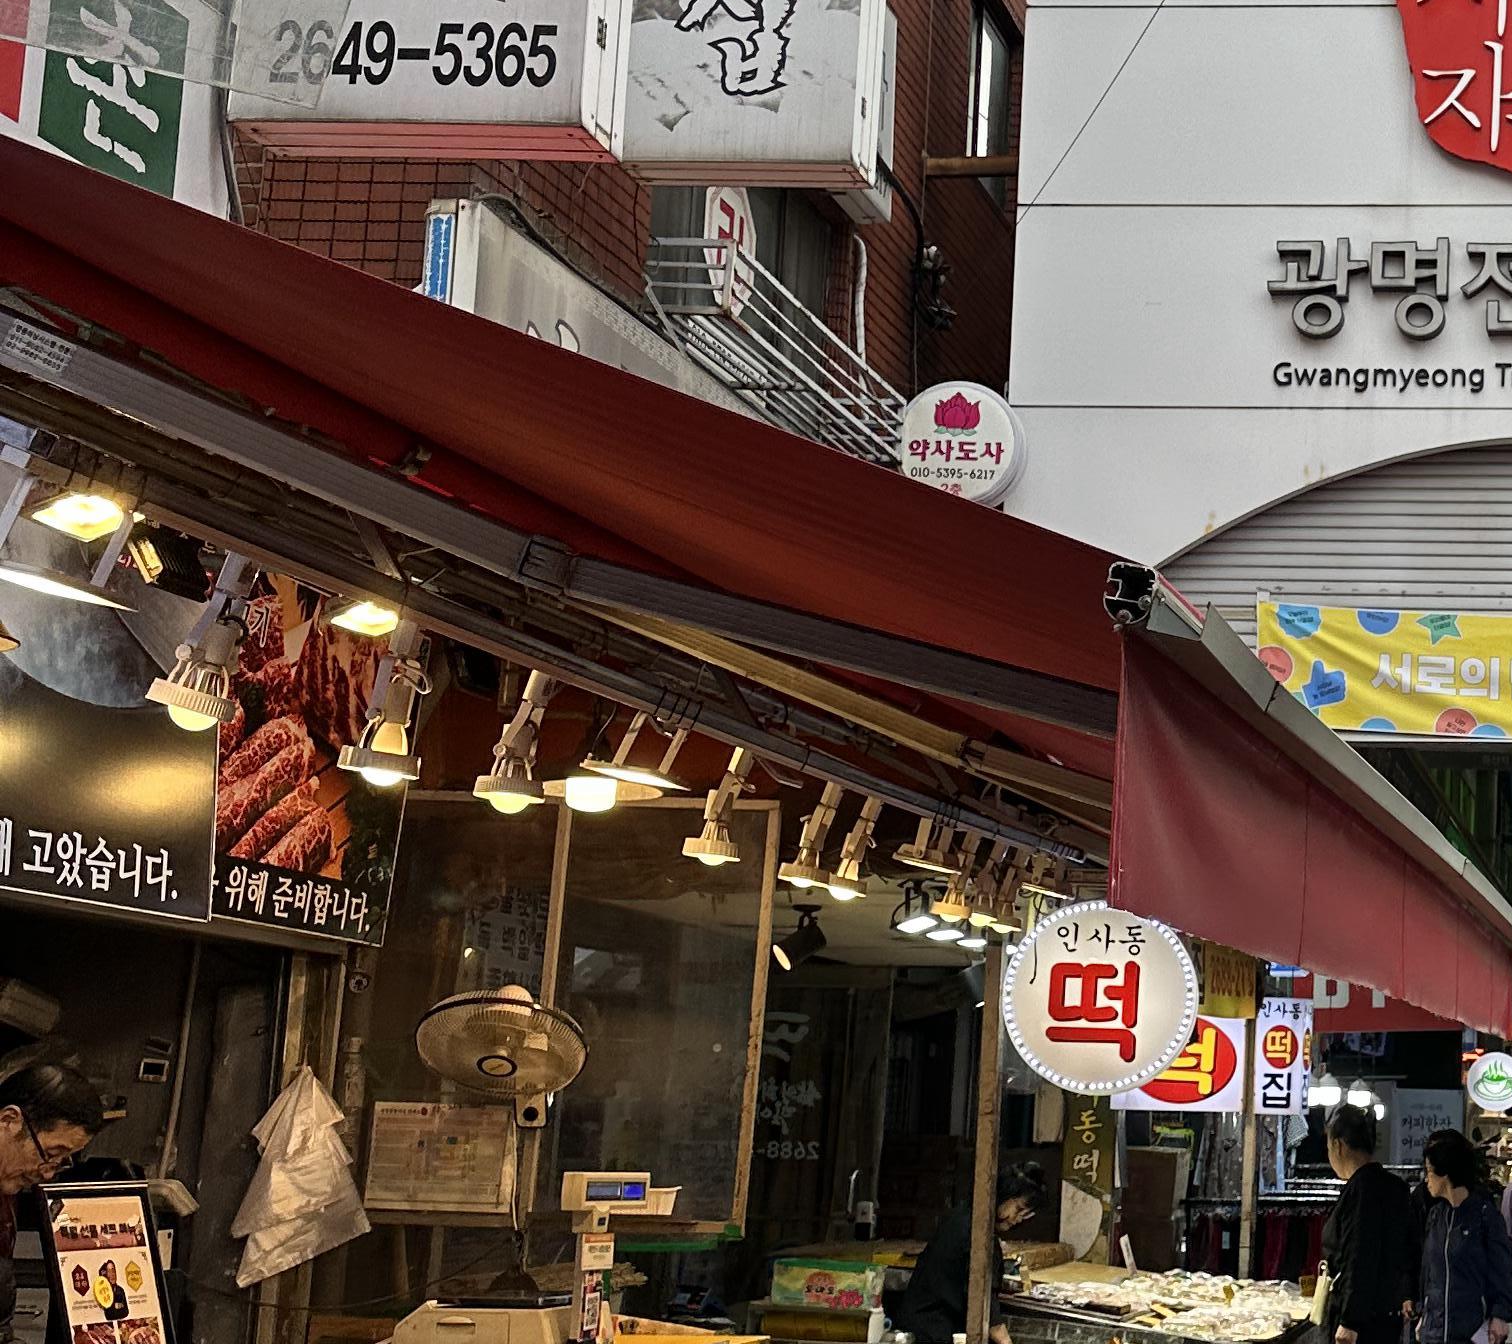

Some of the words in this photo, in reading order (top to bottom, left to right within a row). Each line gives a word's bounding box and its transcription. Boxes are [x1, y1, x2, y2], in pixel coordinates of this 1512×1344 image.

[268, 21, 558, 87] 2649-5365
[1272, 361, 1486, 394] Gwangmyeong
[908, 439, 1005, 465] 약사도사
[910, 466, 995, 480] 010-5395-6217
[1371, 653, 1500, 701] 서로의
[22, 828, 178, 902] 고았습니다.
[225, 865, 269, 916] 위해
[272, 876, 370, 934] 준비합니다.
[1056, 922, 1147, 957] 인사동
[1045, 960, 1141, 1063] 떡
[1261, 1001, 1303, 1021] 인사동
[1265, 1029, 1293, 1065] 떡
[1262, 1072, 1292, 1109] 집
